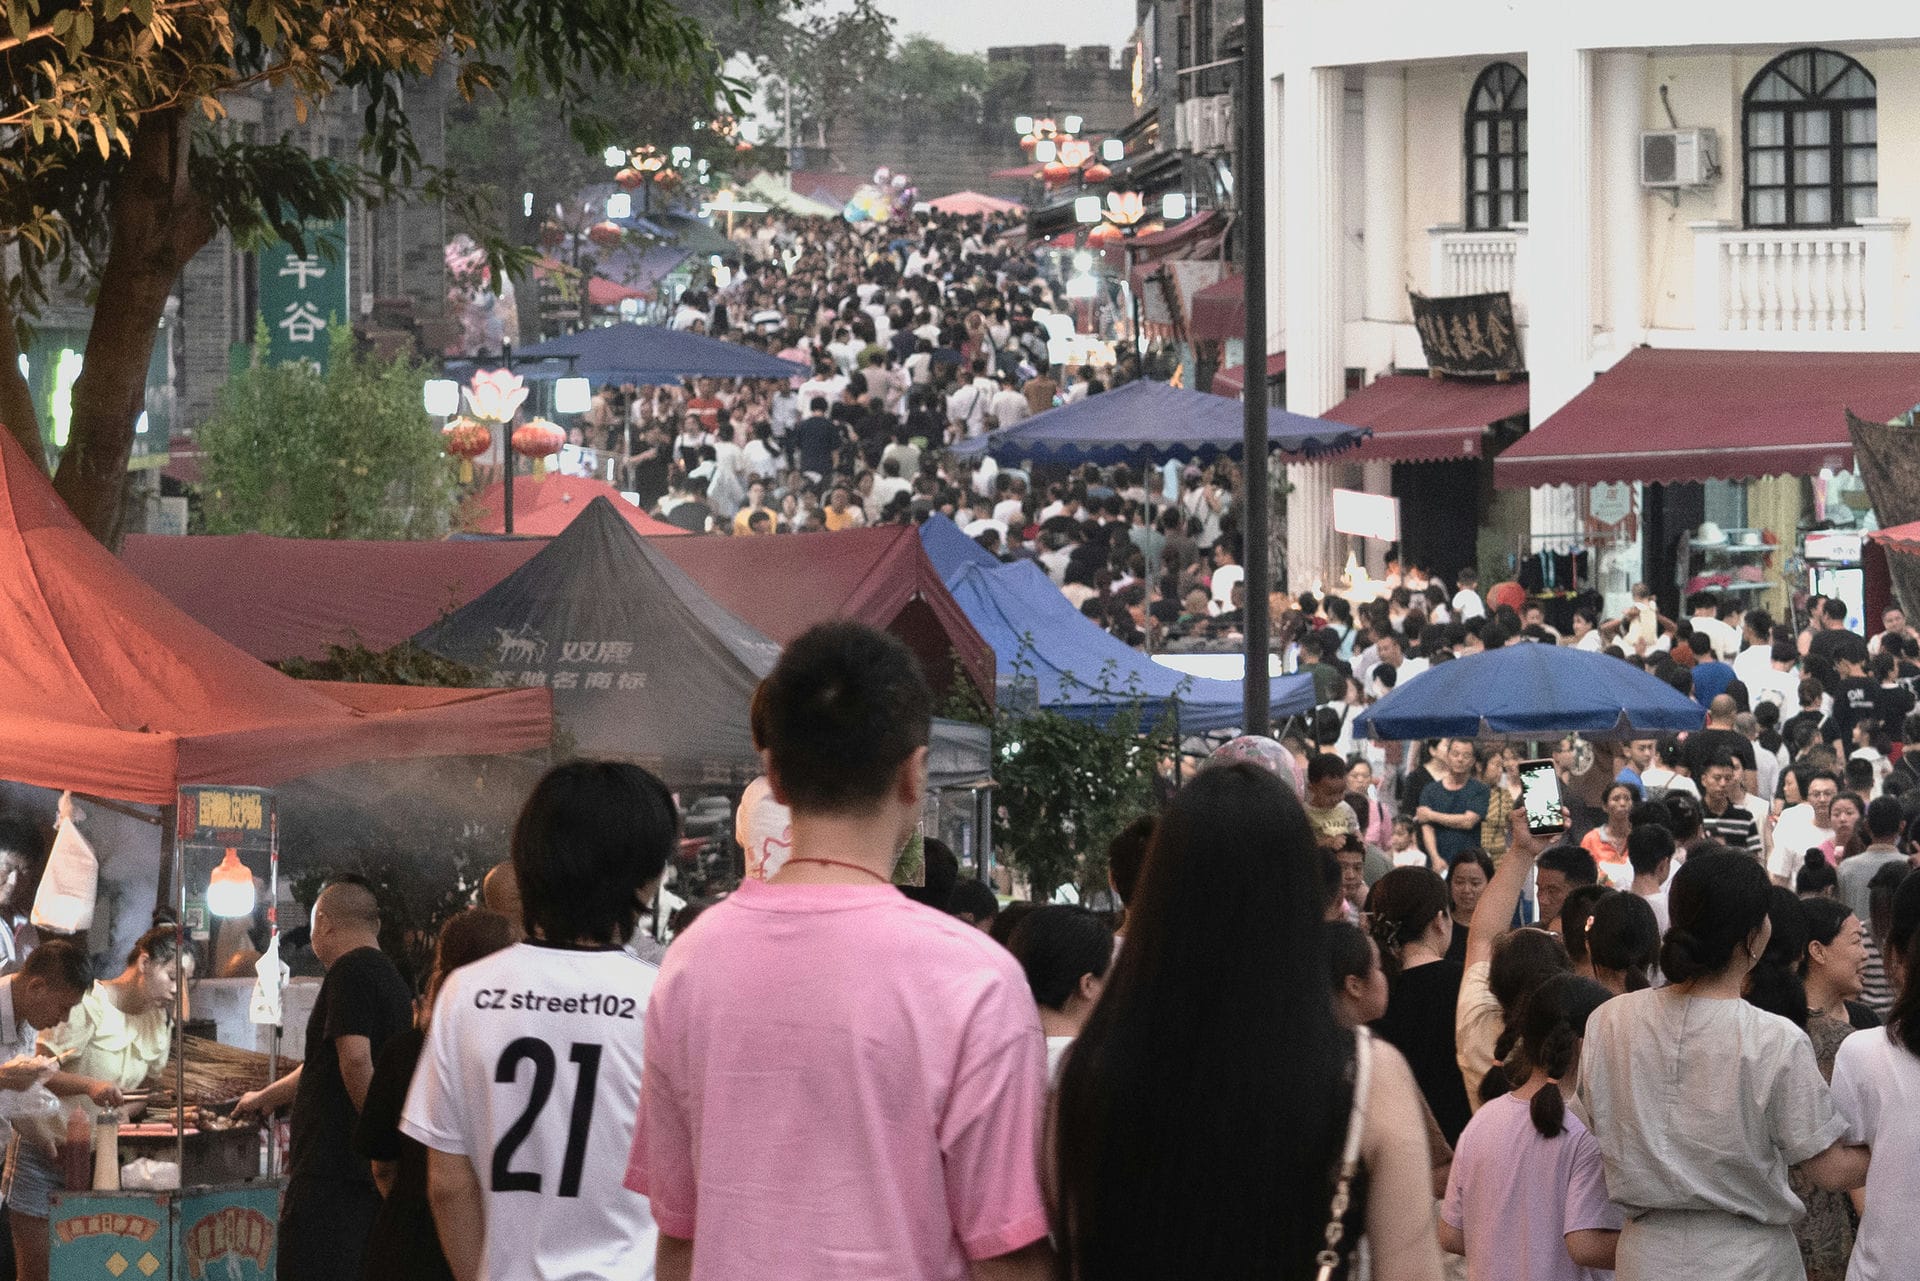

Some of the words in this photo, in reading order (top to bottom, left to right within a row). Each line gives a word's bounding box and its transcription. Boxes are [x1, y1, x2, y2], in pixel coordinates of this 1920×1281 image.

[474, 989, 507, 1010] CZ
[510, 990, 636, 1019] street102
[491, 1036, 603, 1198] 21
